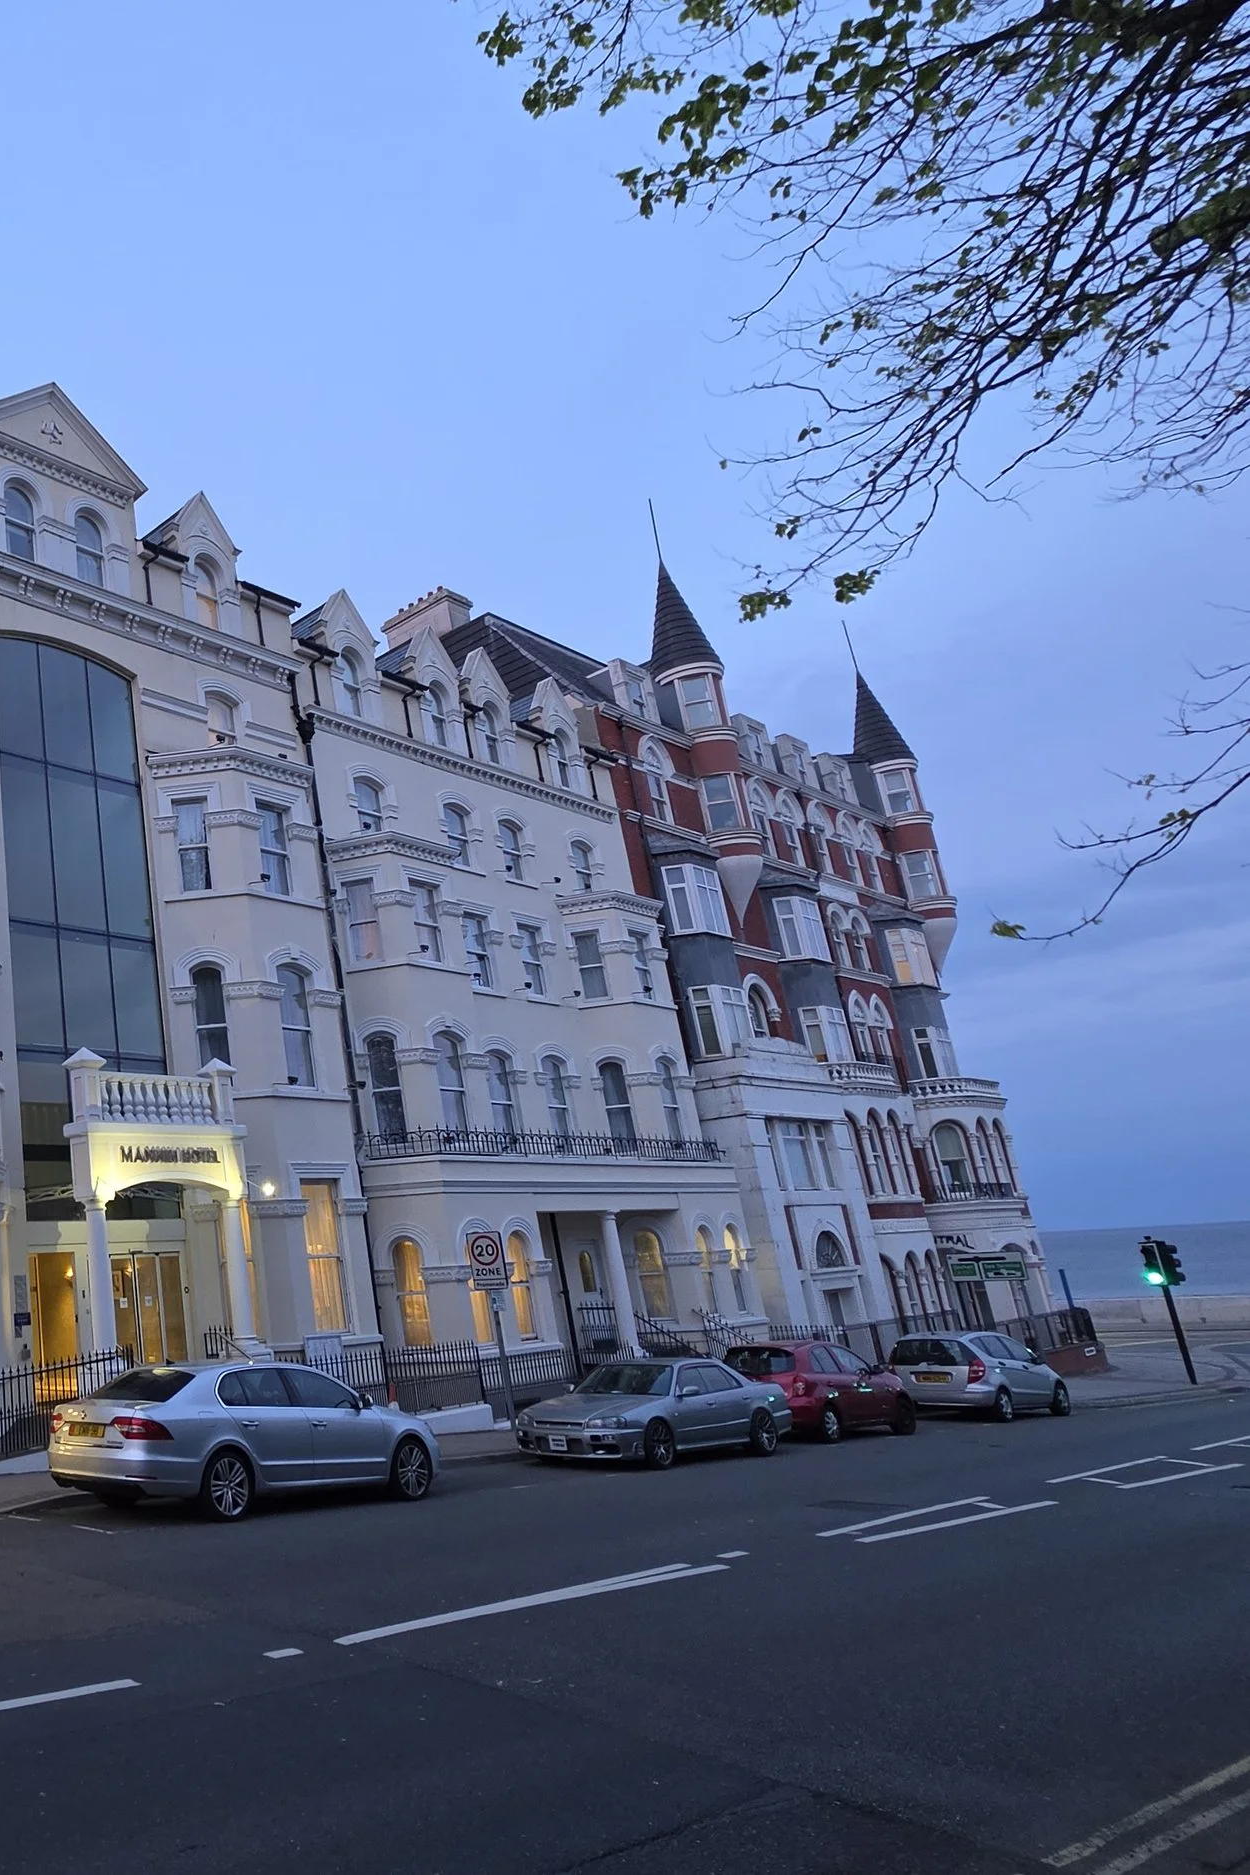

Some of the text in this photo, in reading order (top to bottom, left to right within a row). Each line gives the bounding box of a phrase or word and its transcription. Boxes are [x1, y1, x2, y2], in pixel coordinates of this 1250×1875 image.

[934, 1234, 975, 1250] TRAL
[475, 1244, 495, 1257] 20
[475, 1267, 501, 1276] ZONE
